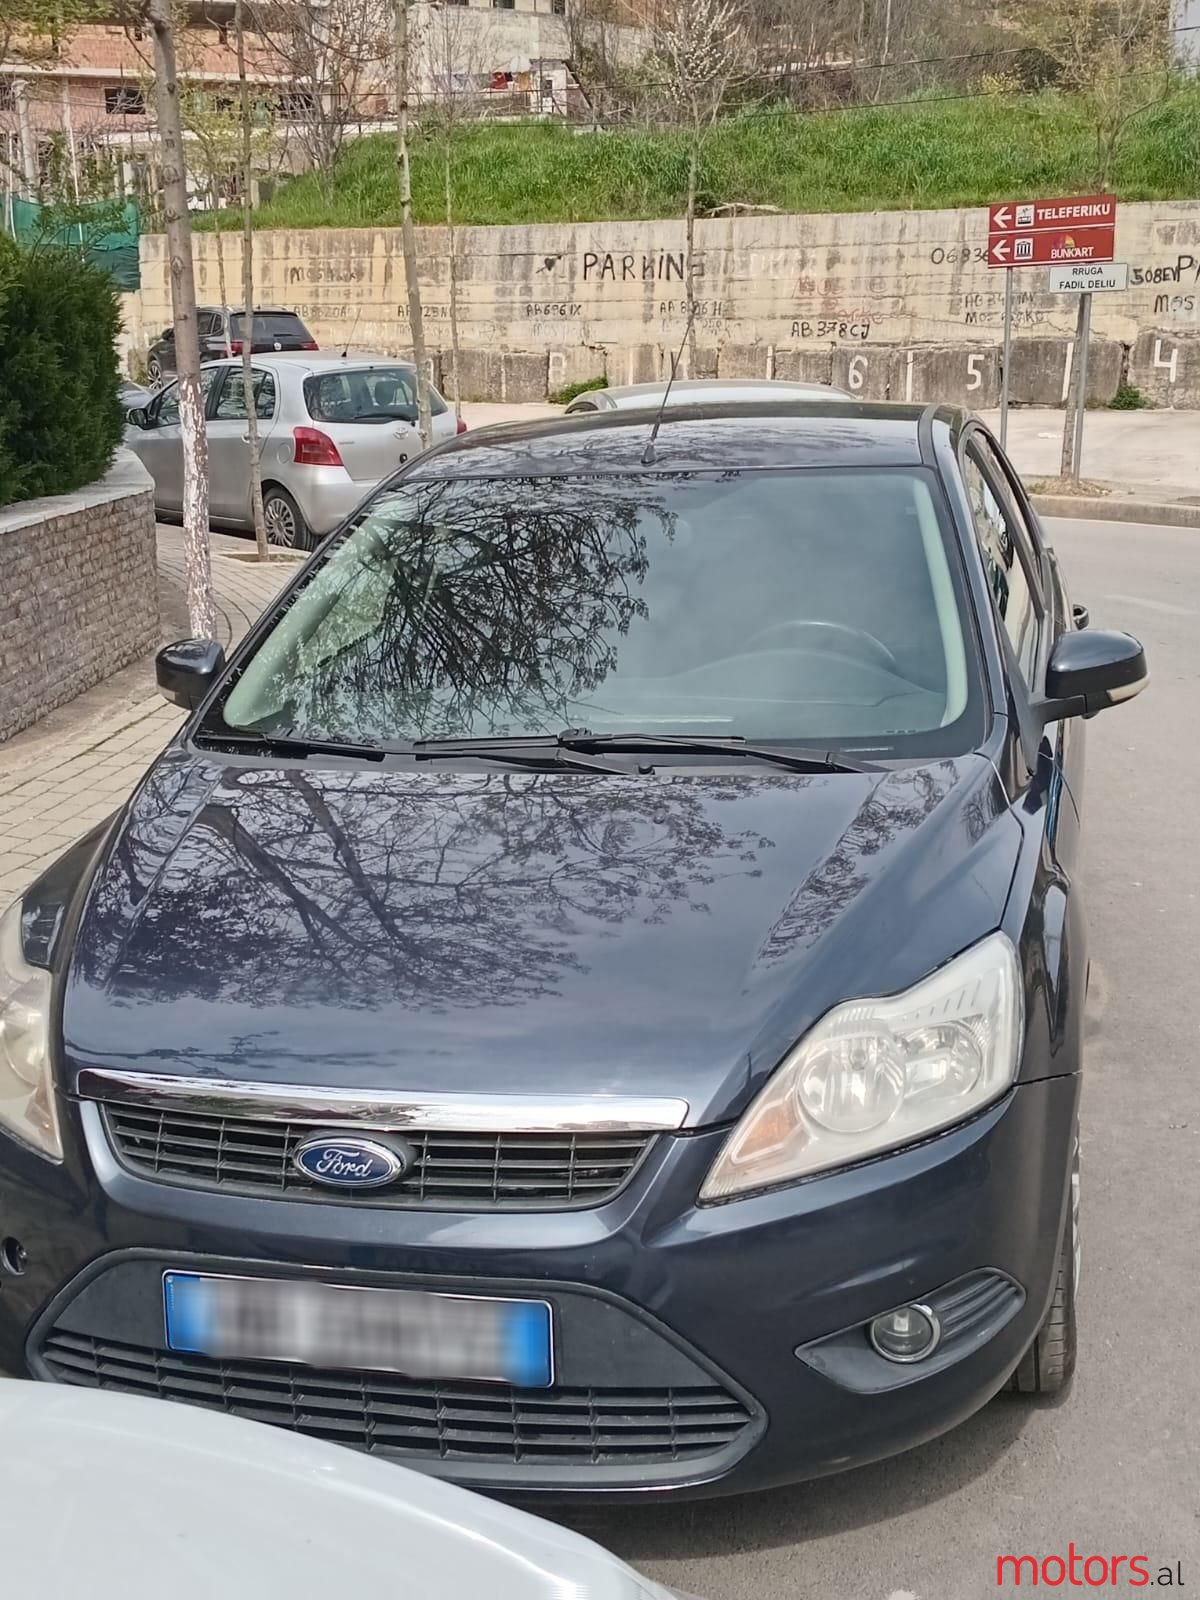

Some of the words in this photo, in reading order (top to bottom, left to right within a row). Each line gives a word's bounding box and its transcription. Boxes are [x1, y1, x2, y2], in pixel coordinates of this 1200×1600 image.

[1036, 203, 1111, 221] TELEFERIKU
[1059, 280, 1085, 290] FADIL
[1087, 279, 1116, 289] DELIU
[1072, 266, 1104, 276] RRUGA
[848, 354, 869, 390] 6
[966, 353, 985, 391] 5
[1153, 339, 1179, 383] 4
[315, 1148, 374, 1178] Ford
